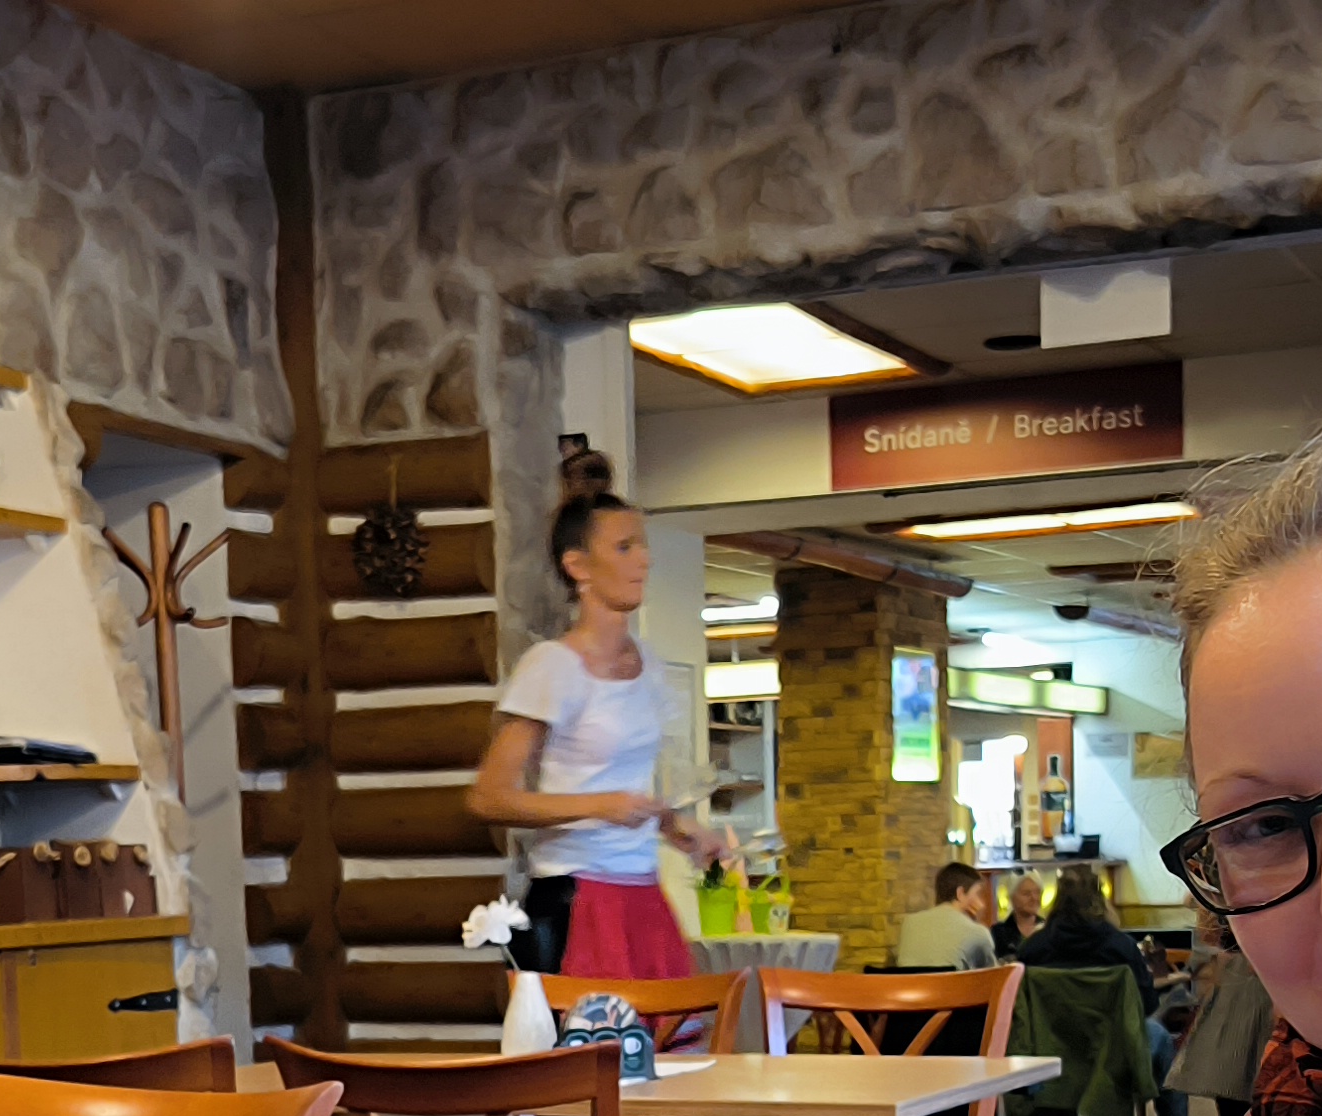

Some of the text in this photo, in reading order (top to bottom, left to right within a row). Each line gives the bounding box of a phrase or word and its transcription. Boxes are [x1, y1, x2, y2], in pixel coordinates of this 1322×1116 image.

[863, 403, 1144, 454] Snídaně / Breakfast
